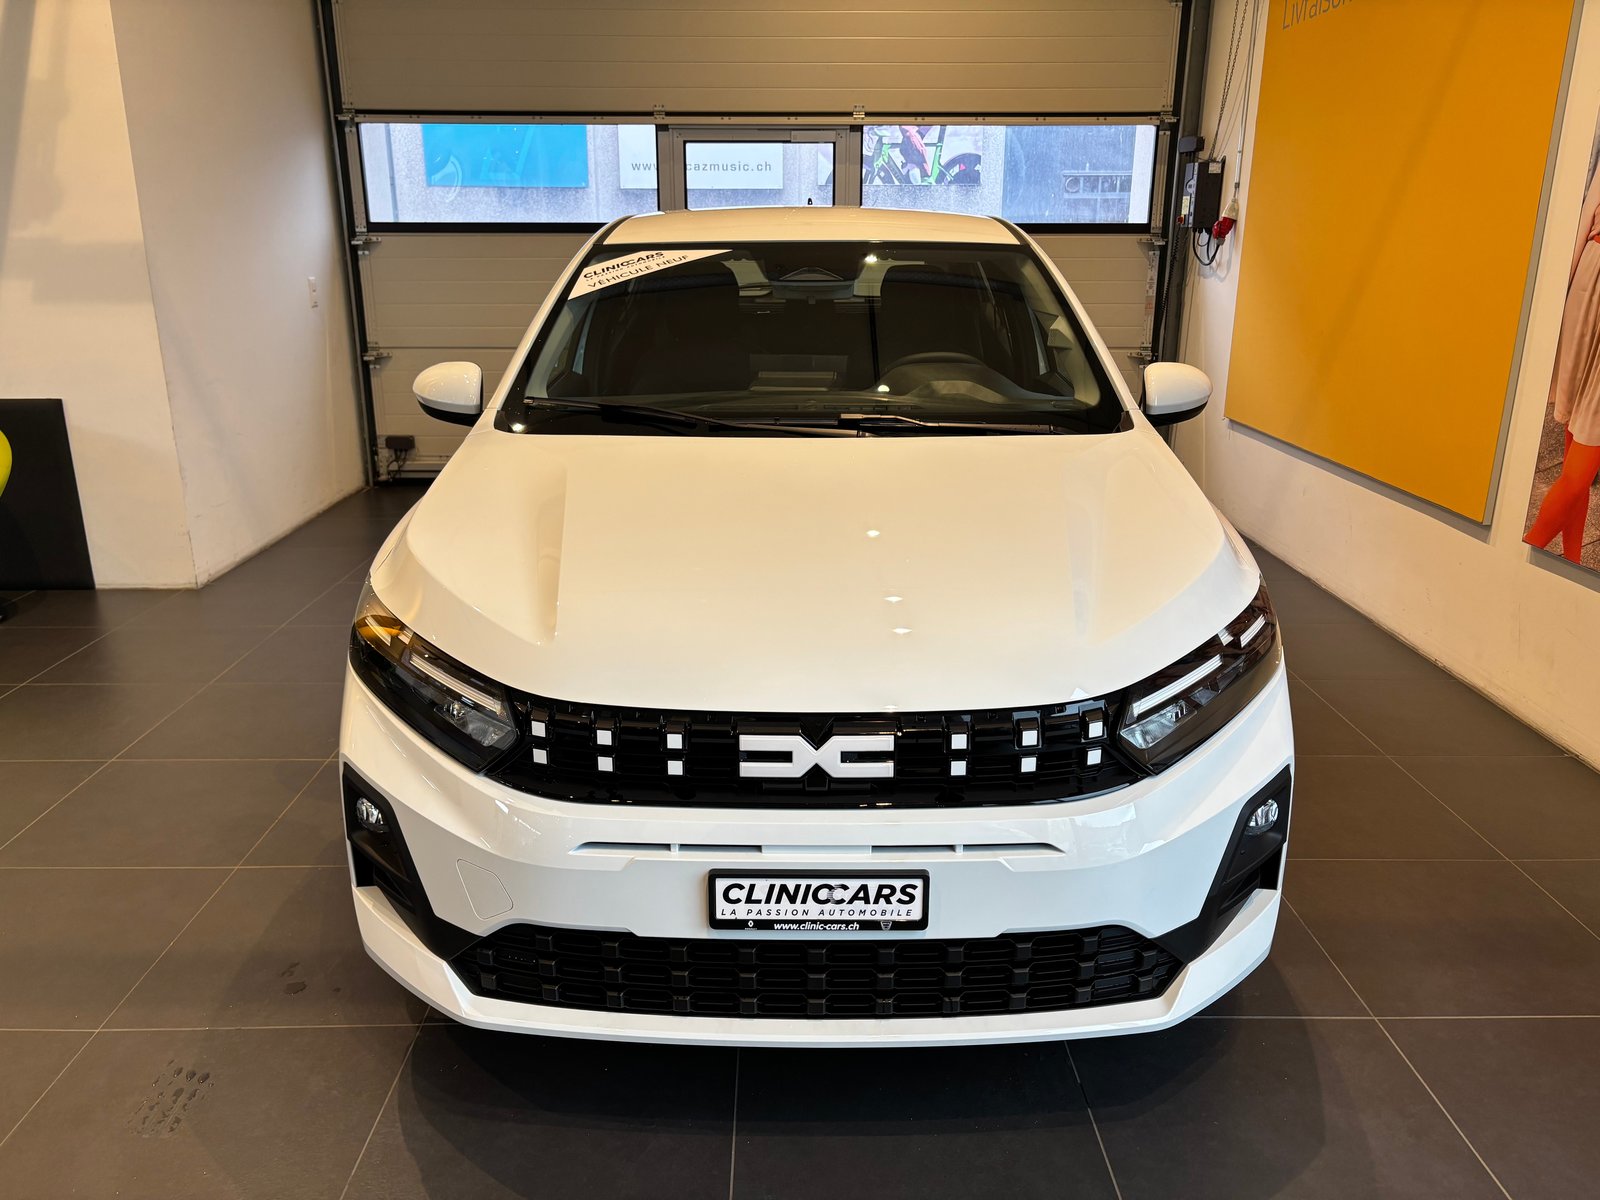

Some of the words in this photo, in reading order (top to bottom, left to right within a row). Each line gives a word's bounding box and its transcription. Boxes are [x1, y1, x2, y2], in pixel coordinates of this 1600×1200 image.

[655, 254, 688, 268] NEUF
[722, 883, 918, 905] CLINICCARS
[721, 908, 737, 916] LA
[746, 908, 810, 916] PASSION
[818, 908, 913, 916] AUTOMOBILE
[773, 921, 860, 931] www.clinic-cars.ch
